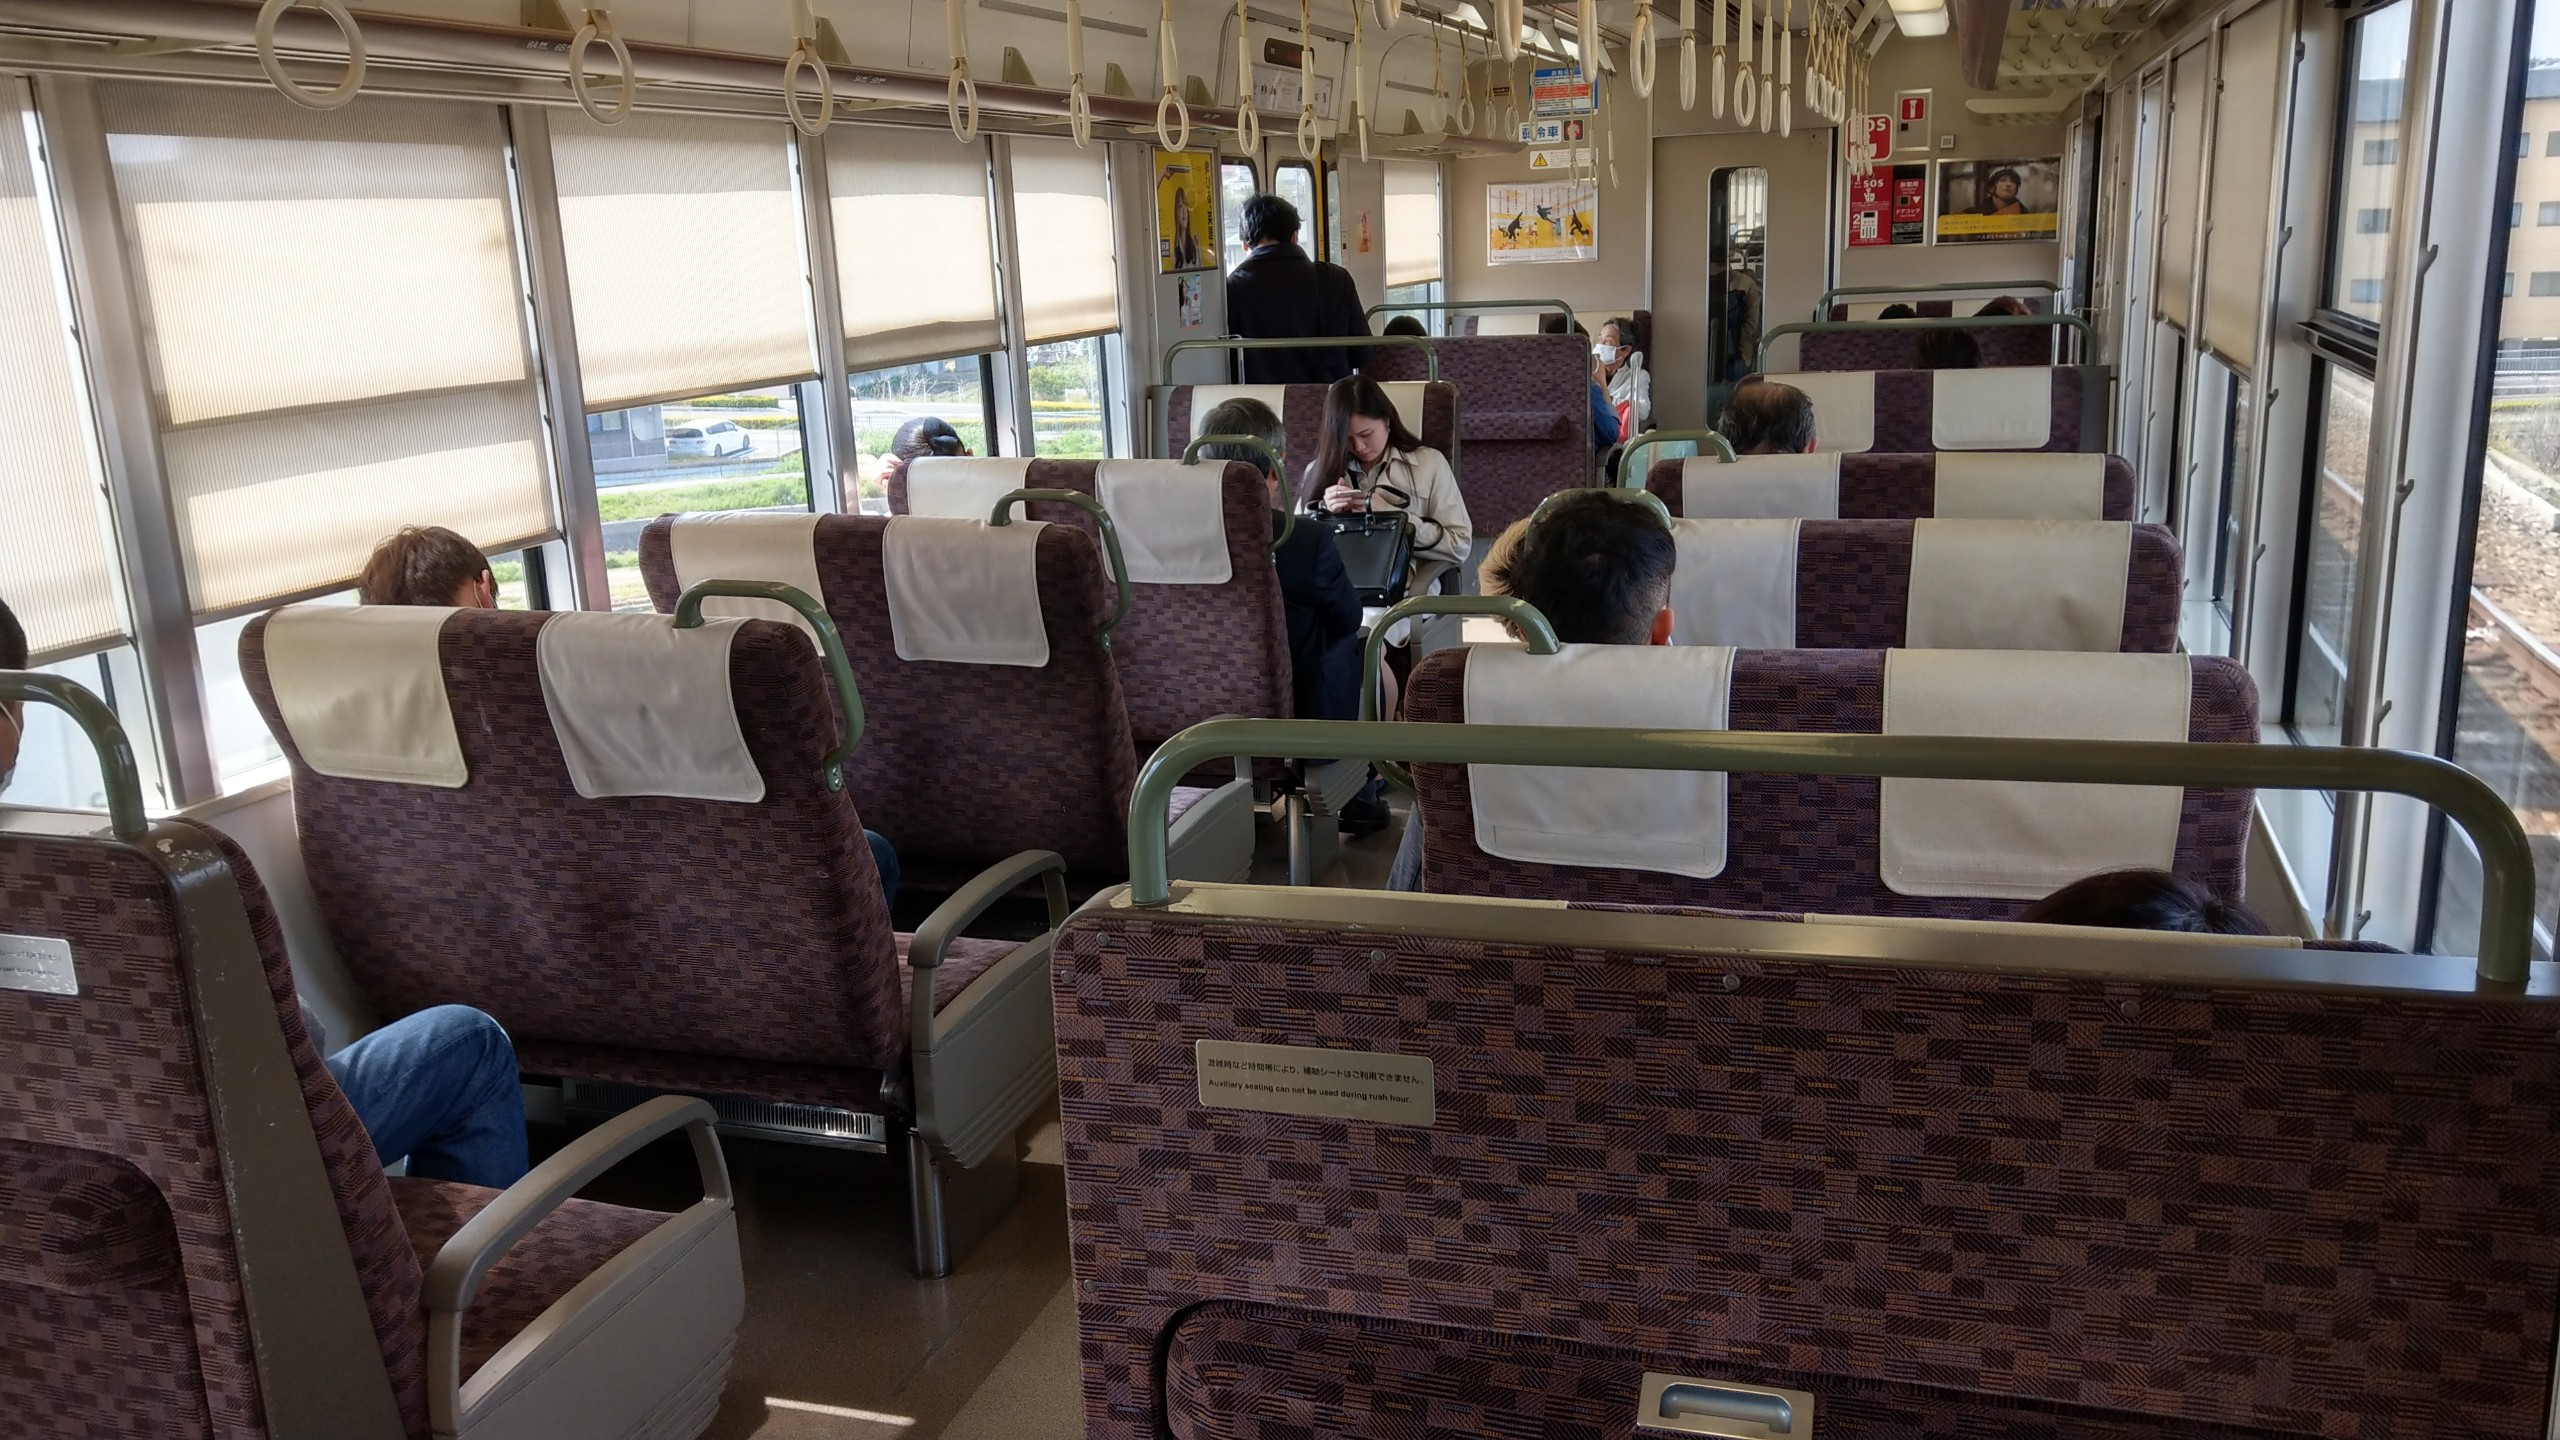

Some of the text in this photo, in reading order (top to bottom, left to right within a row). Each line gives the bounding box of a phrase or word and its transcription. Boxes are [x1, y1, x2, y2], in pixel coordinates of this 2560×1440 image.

[1863, 179, 1884, 188] SOS
[1853, 214, 1861, 225] 2
[1208, 1079, 1243, 1090] Auxiliary
[1245, 1082, 1274, 1093] seating
[1275, 1085, 1290, 1093] can
[1307, 1087, 1317, 1095] be
[1319, 1088, 1339, 1097] used
[1340, 1089, 1367, 1101] during
[1369, 1092, 1388, 1102] rush
[1390, 1094, 1413, 1103] hour.
